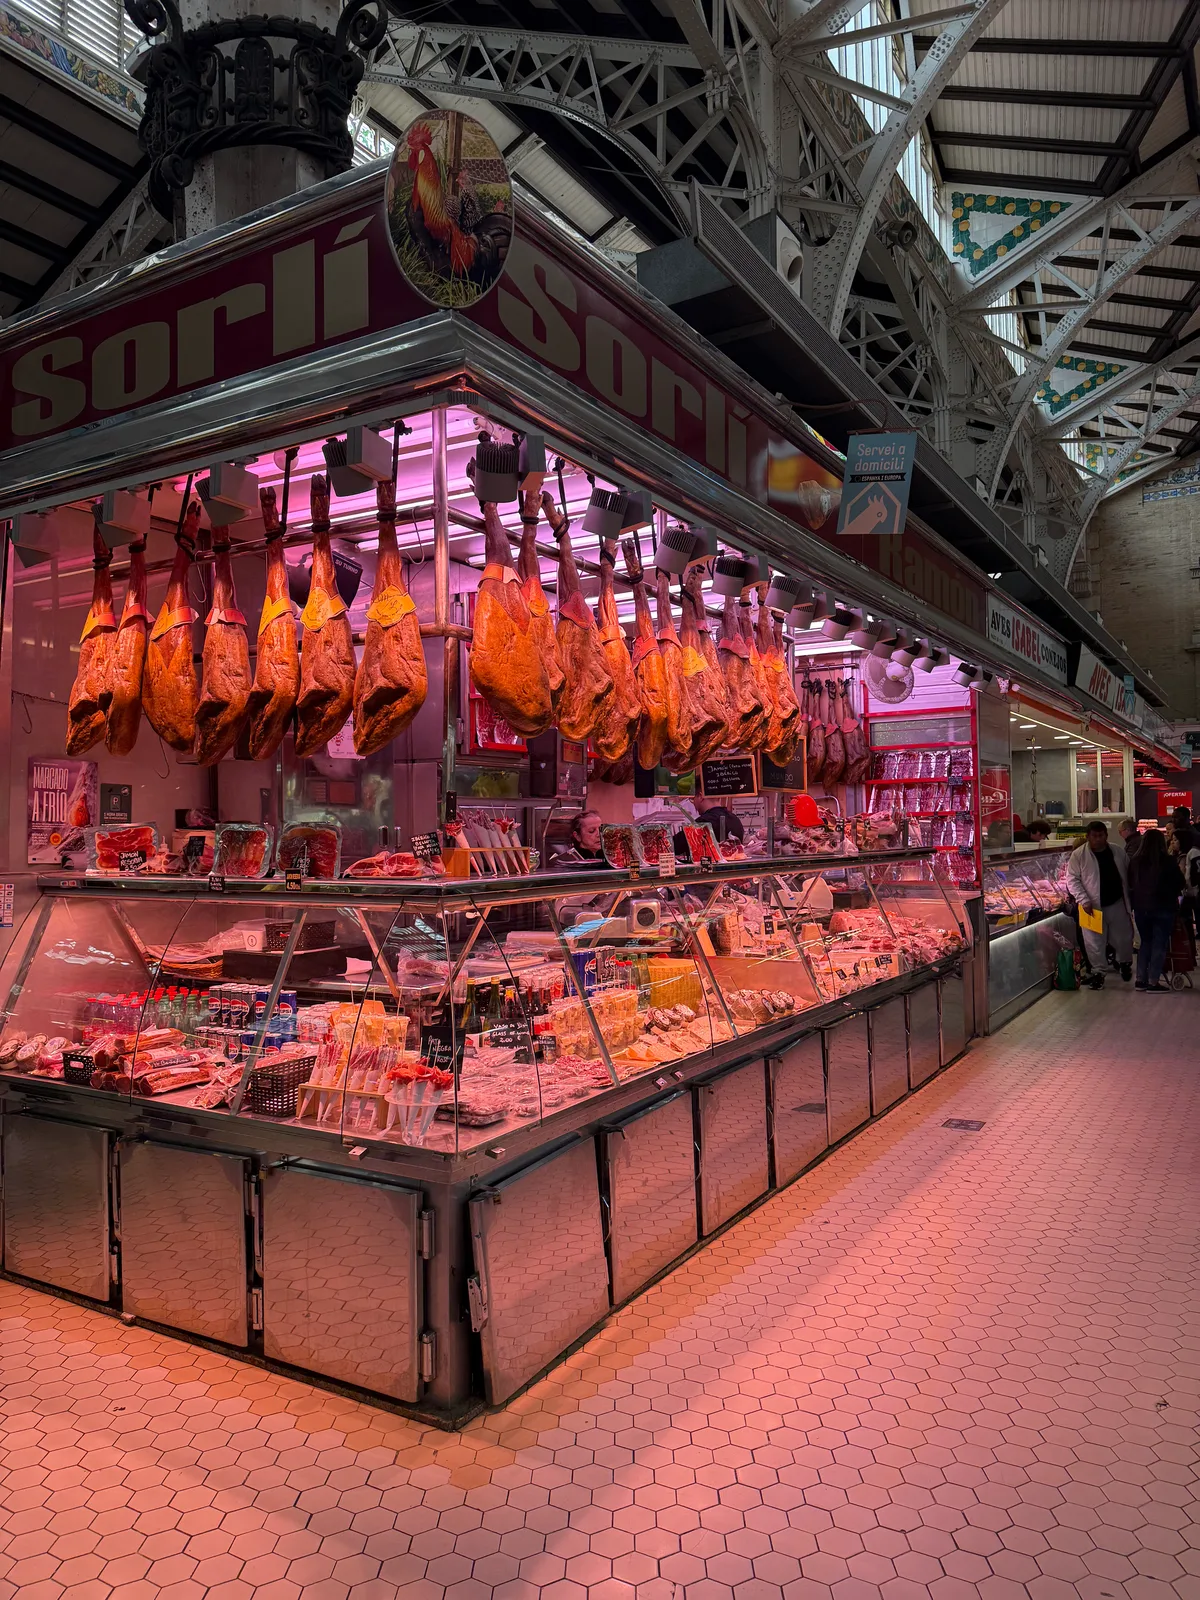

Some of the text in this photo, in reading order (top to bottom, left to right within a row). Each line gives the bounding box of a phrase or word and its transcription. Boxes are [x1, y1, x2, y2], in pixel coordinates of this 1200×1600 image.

[11, 215, 376, 436] Sorlí
[498, 236, 751, 489] Sorlí
[855, 457, 905, 472] domicili
[857, 442, 906, 457] Servei a
[343, 563, 358, 574] TURNO
[990, 609, 1011, 639] AVES
[1011, 616, 1041, 665] ISABEL
[1041, 643, 1067, 675] CONEJOS
[1088, 662, 1112, 703] AVES
[33, 766, 69, 790] MARCADO
[32, 789, 67, 823] A FRÍO
